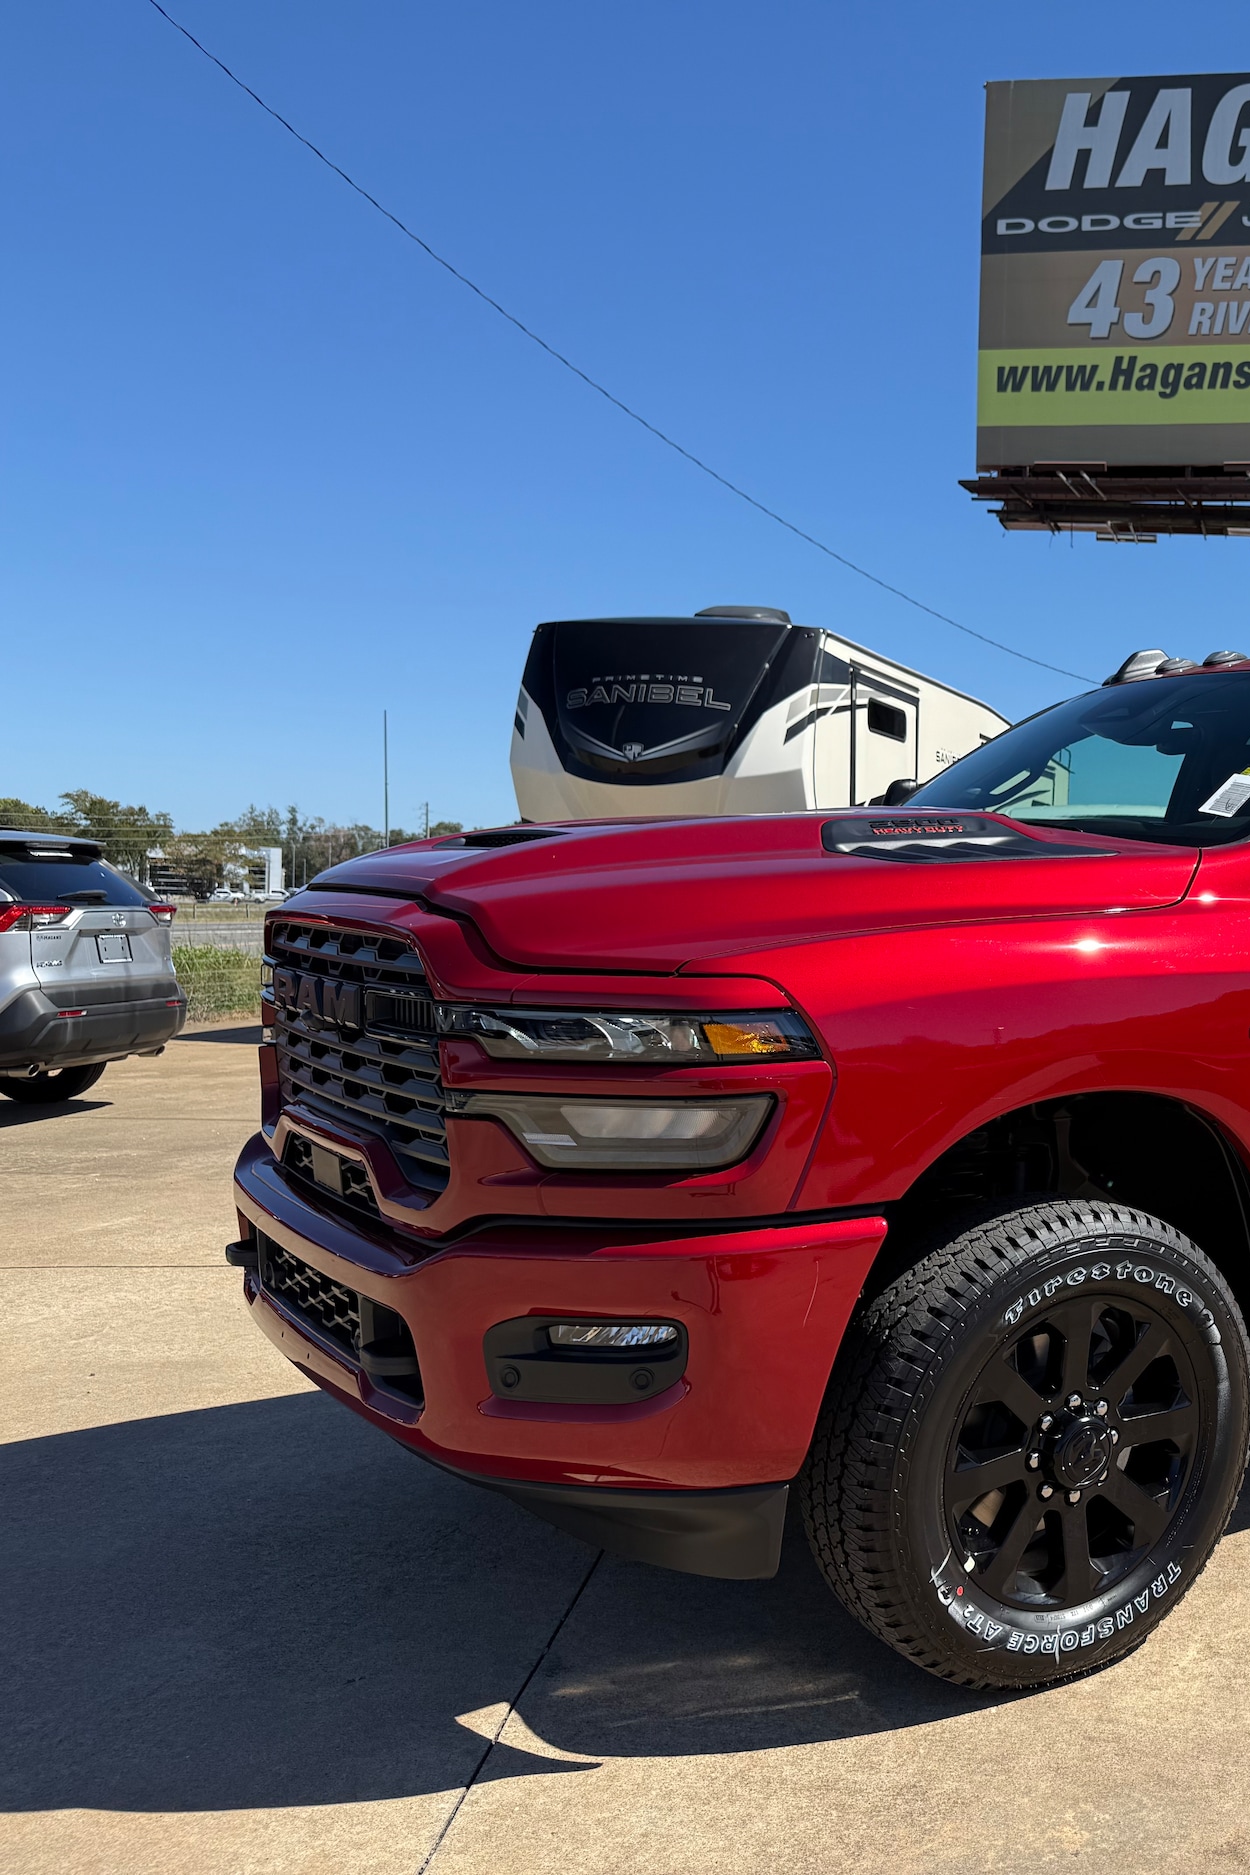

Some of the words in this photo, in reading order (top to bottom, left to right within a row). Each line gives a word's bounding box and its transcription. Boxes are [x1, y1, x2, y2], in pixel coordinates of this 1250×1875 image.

[996, 210, 1203, 236] DODGE
[1066, 256, 1181, 340] 43
[566, 683, 731, 712] SANIBEL
[273, 966, 361, 1030] RAM
[1004, 1260, 1193, 1324] Firestone
[1006, 1561, 1182, 1654] TRANSFORCE
